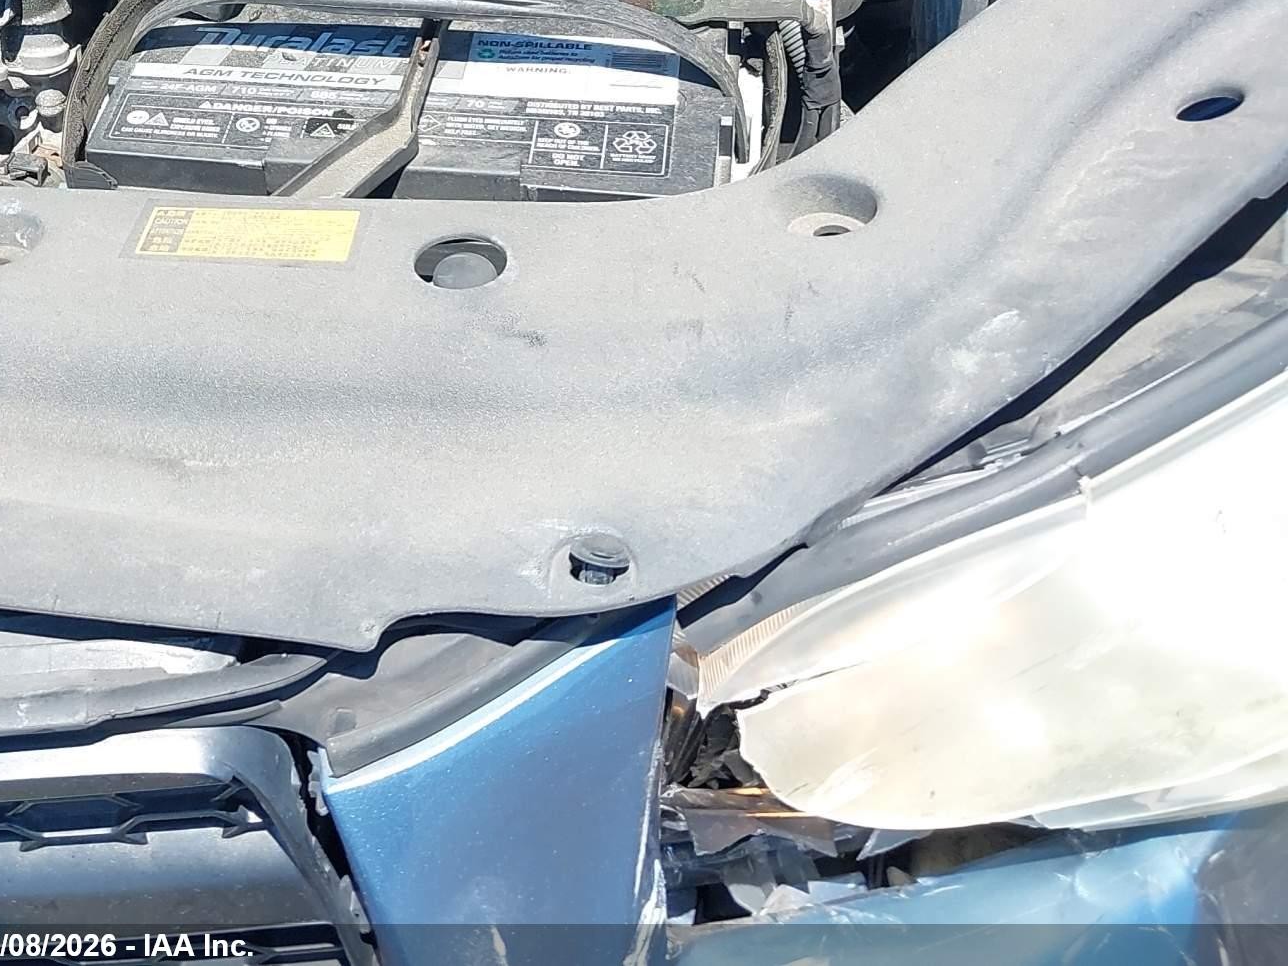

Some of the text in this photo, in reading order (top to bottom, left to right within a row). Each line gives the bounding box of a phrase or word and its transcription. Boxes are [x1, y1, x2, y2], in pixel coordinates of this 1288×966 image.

[195, 26, 409, 57] Duralast
[477, 39, 593, 51] NON-SPILLABLE
[183, 68, 386, 86] AGM TECHNOLOGY
[232, 86, 257, 95] 710
[213, 102, 333, 117] DANGER/POISON
